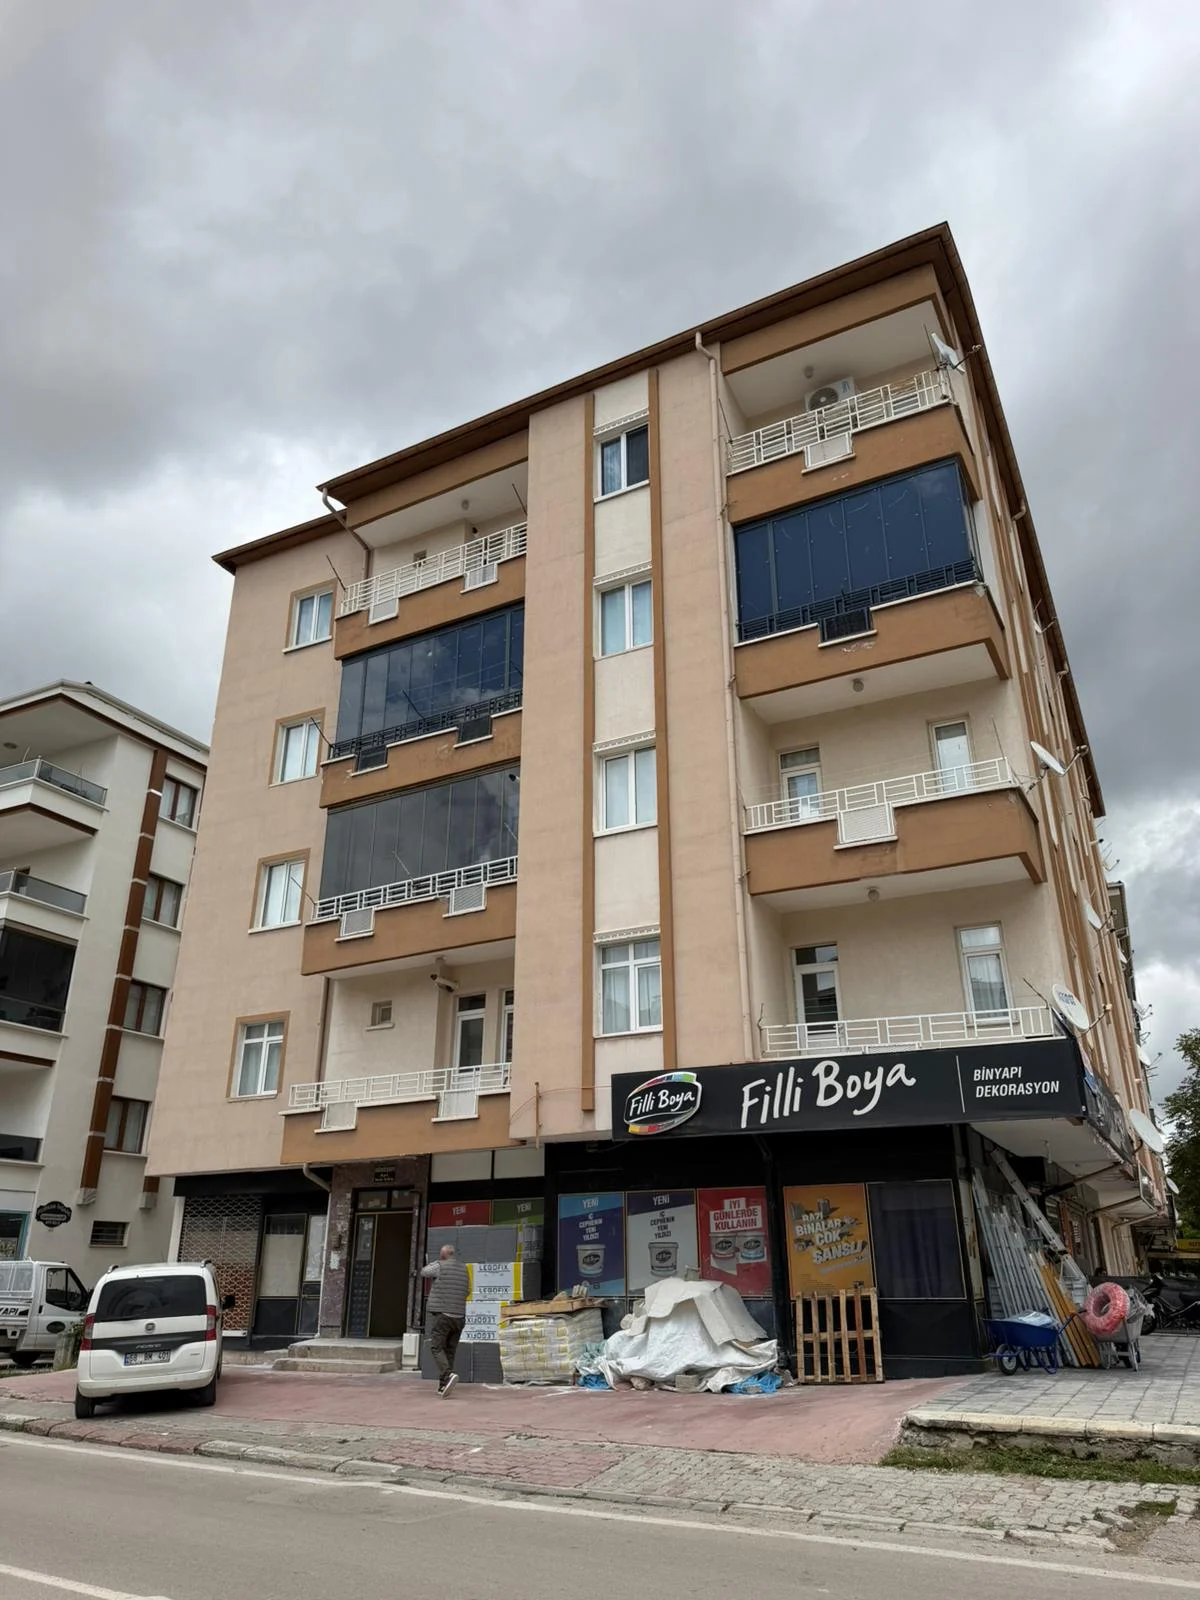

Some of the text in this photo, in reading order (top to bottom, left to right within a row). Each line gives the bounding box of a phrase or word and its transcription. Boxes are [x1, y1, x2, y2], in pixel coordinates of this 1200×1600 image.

[973, 1066, 1022, 1081] BİNYAPI
[741, 1060, 917, 1129] Filli Boya
[975, 1080, 1060, 1098] DEKORASYON
[629, 1089, 696, 1117] Filli Boya
[713, 1207, 759, 1221] GÜNLERDE
[715, 1218, 757, 1231] KULLANIN
